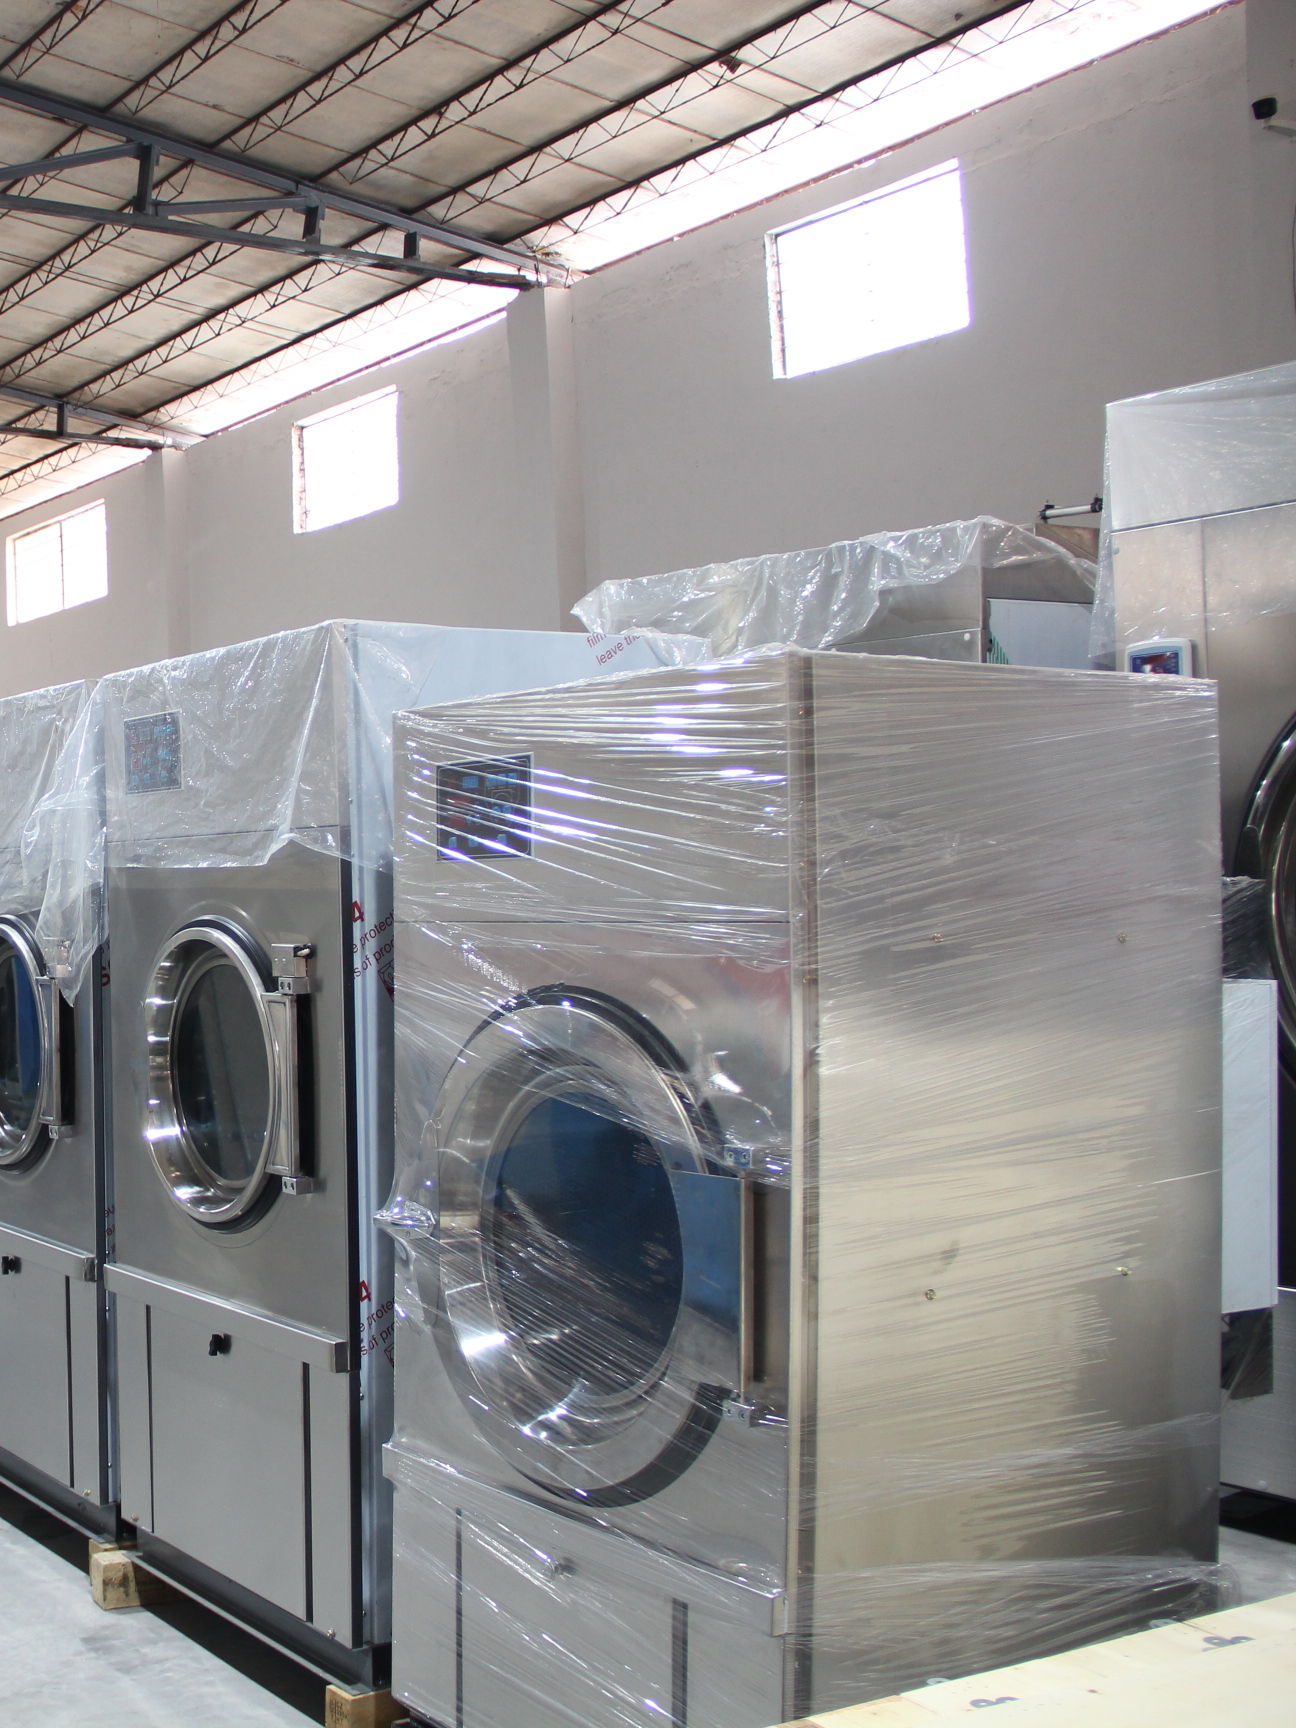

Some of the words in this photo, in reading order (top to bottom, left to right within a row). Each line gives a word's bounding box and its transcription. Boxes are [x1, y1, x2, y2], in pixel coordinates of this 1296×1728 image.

[595, 641, 624, 666] leave
[351, 900, 365, 923] 4
[361, 954, 373, 971] of
[359, 1279, 372, 1303] 4
[366, 1296, 394, 1330] prote
[368, 1334, 379, 1351] of
